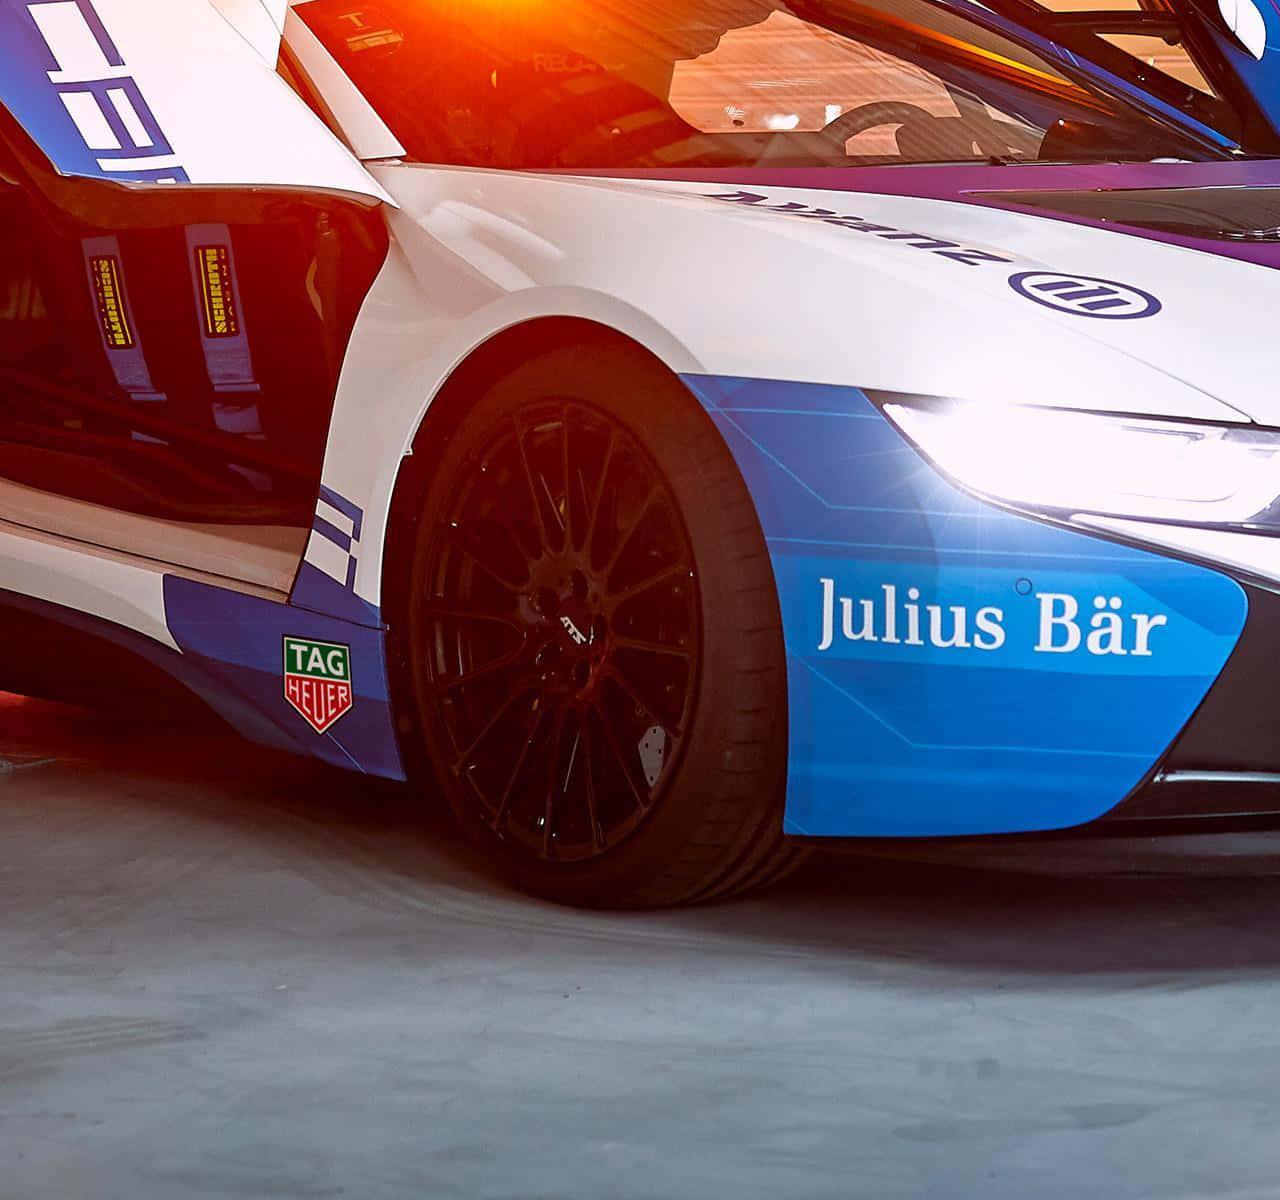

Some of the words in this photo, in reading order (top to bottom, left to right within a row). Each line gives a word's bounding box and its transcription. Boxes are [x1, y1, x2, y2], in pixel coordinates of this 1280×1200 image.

[205, 248, 228, 334] SCHROTH
[818, 577, 1006, 652] Julius
[1034, 590, 1167, 658] Bär
[289, 643, 345, 677] TAG
[287, 677, 349, 724] HEUER
